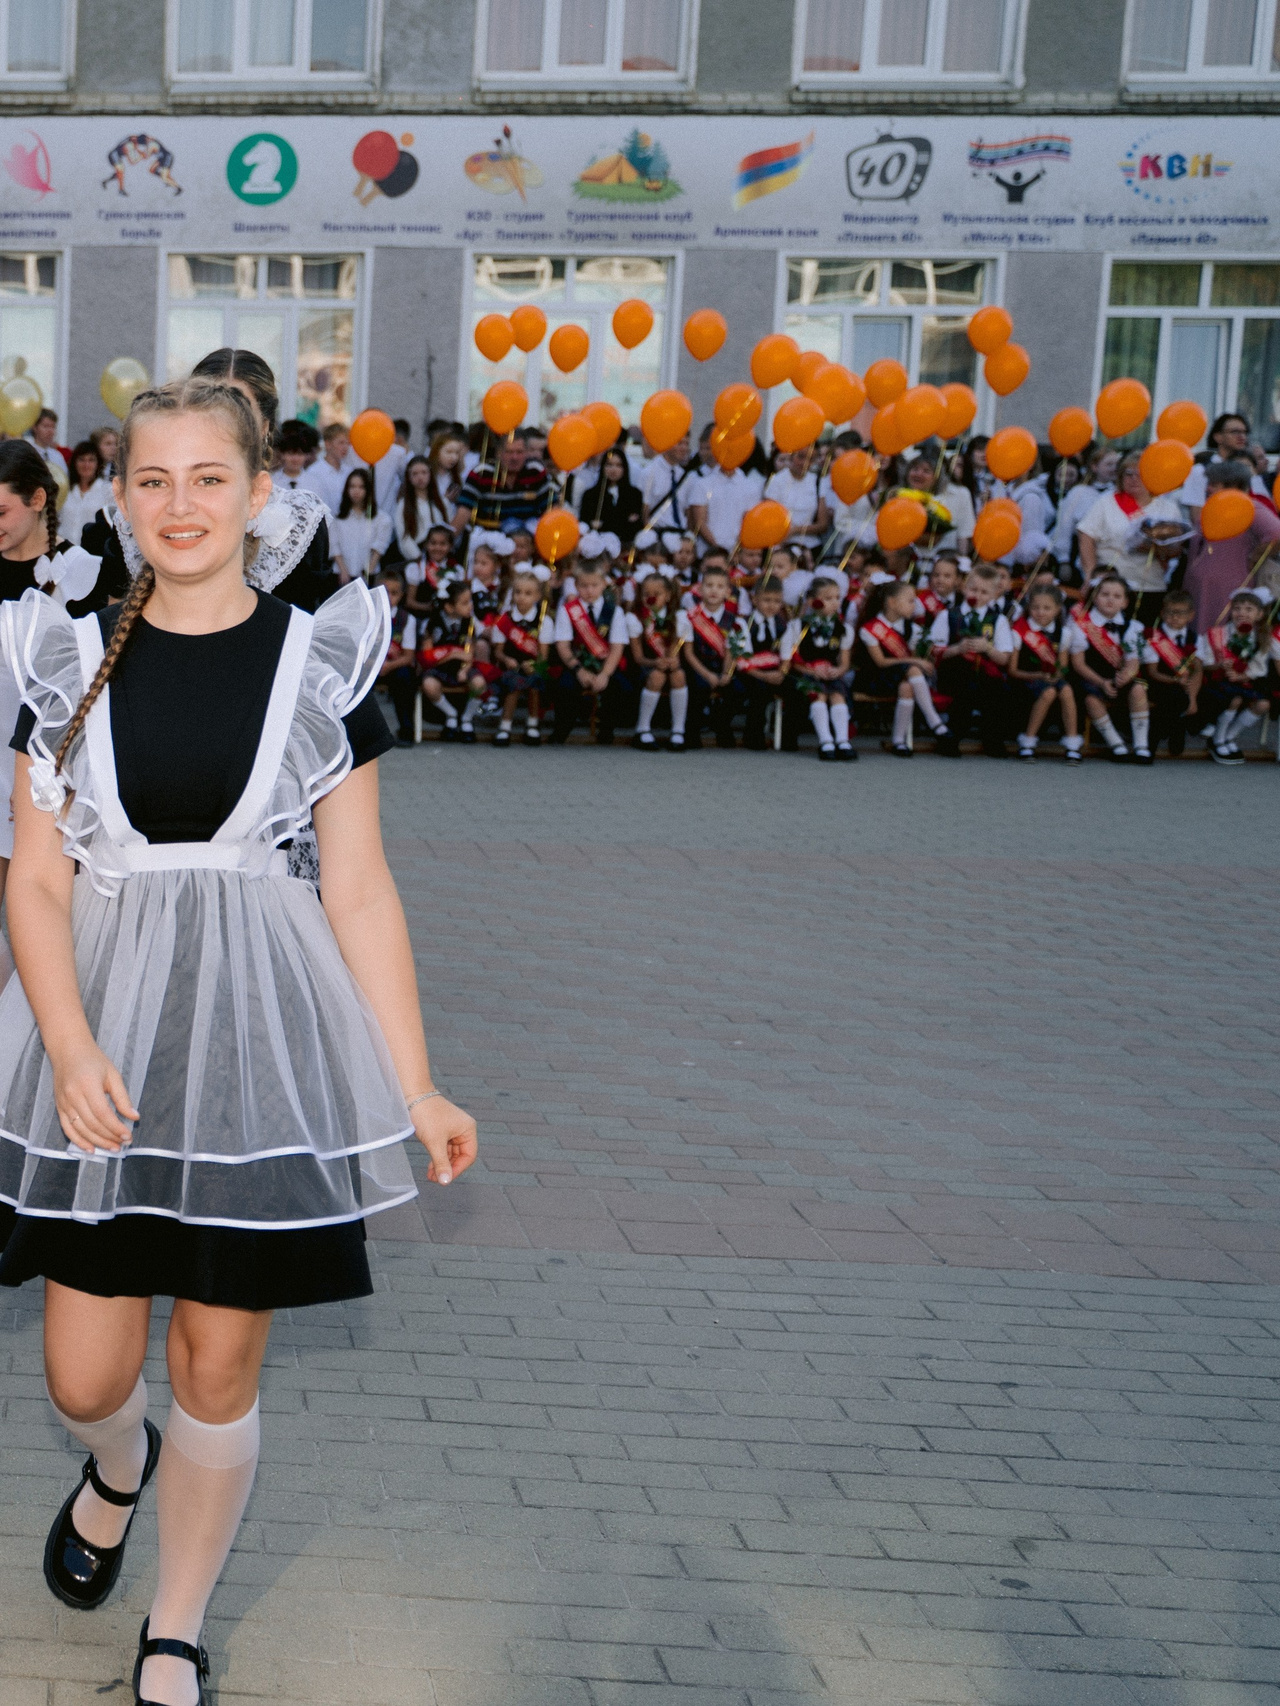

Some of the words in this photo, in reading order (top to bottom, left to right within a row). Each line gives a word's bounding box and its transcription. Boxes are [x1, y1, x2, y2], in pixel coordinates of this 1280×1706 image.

[857, 151, 907, 187] 40
[1138, 152, 1213, 180] КВН
[567, 210, 661, 224] Туристический
[233, 222, 290, 234] Шахматы
[322, 222, 396, 233] Настольный
